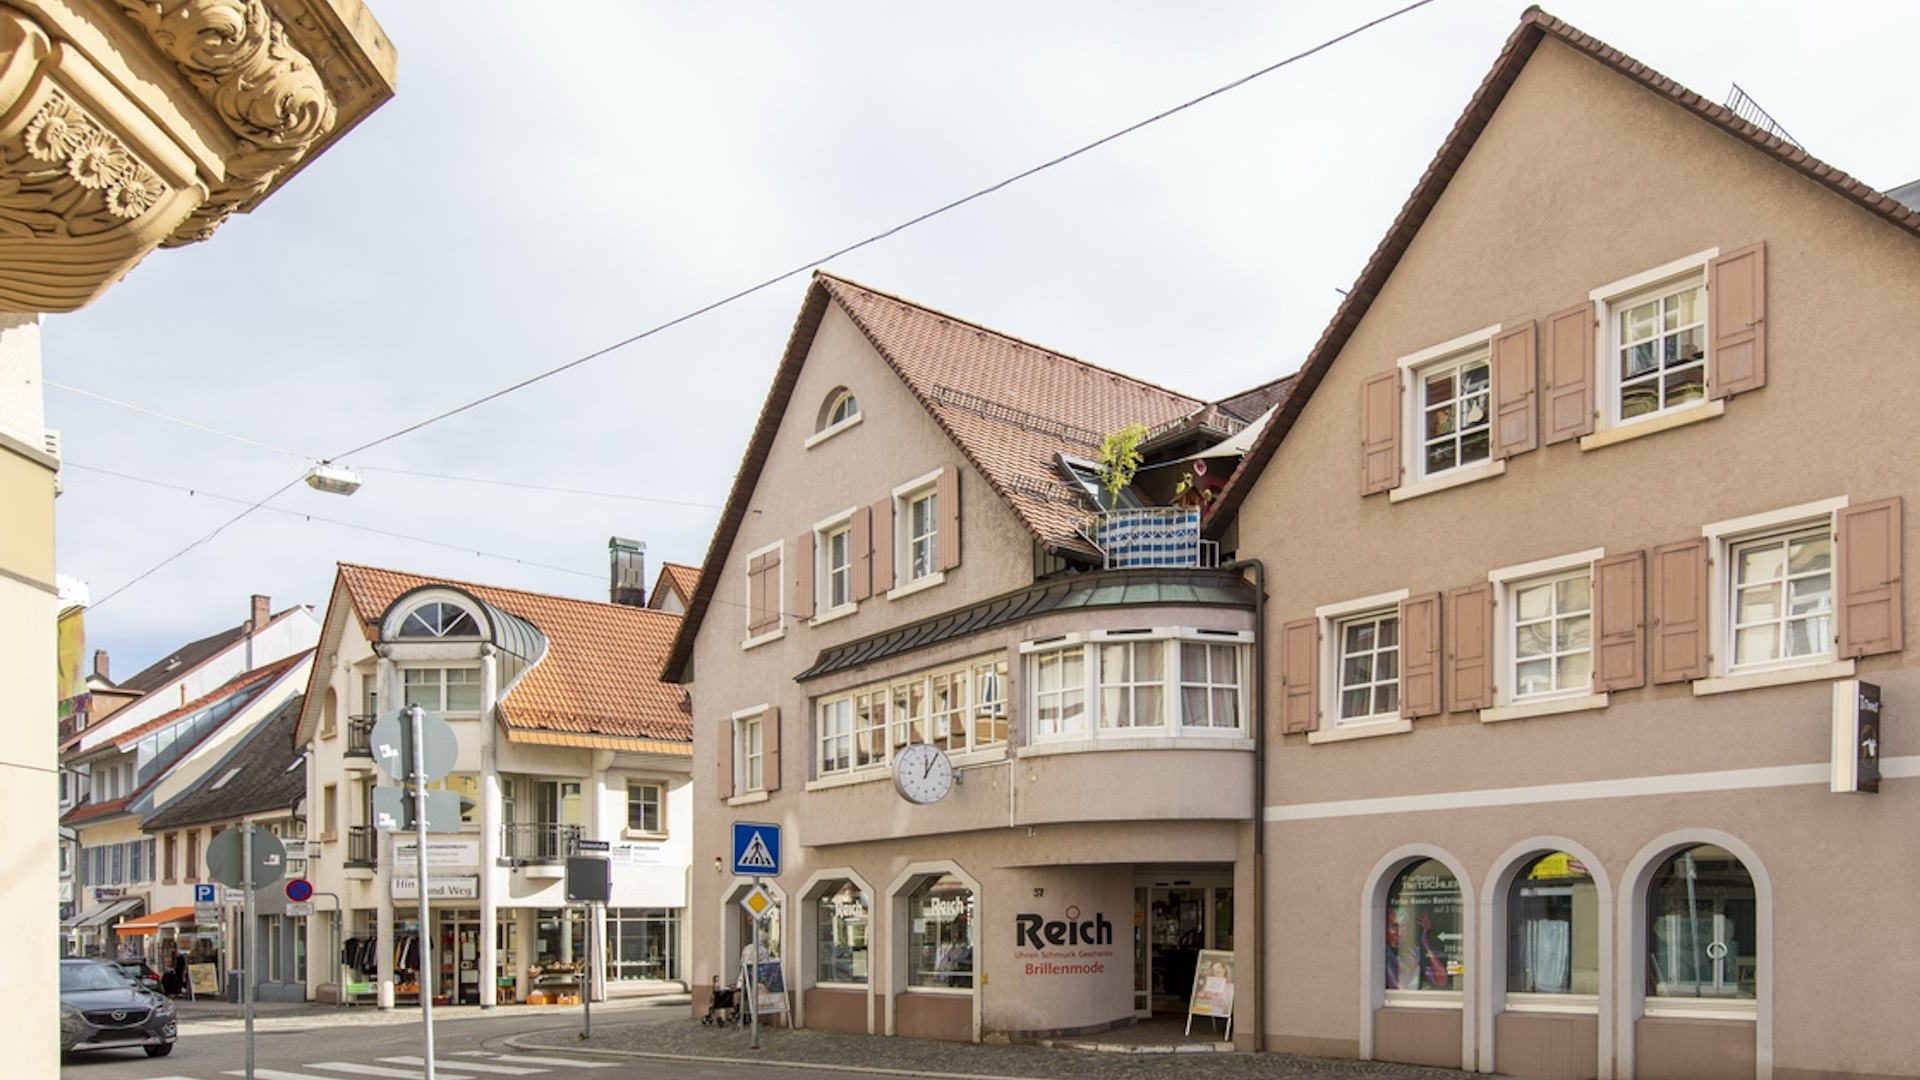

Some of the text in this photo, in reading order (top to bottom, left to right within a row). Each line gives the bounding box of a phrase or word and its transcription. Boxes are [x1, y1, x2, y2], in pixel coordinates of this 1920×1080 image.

[396, 880, 415, 889] Hin
[448, 886, 472, 896] Weg
[198, 886, 211, 902] P
[835, 900, 862, 917] Reich
[931, 896, 964, 916] Reich
[1016, 905, 1112, 950] Reich
[1025, 961, 1105, 975] Brillenmode
